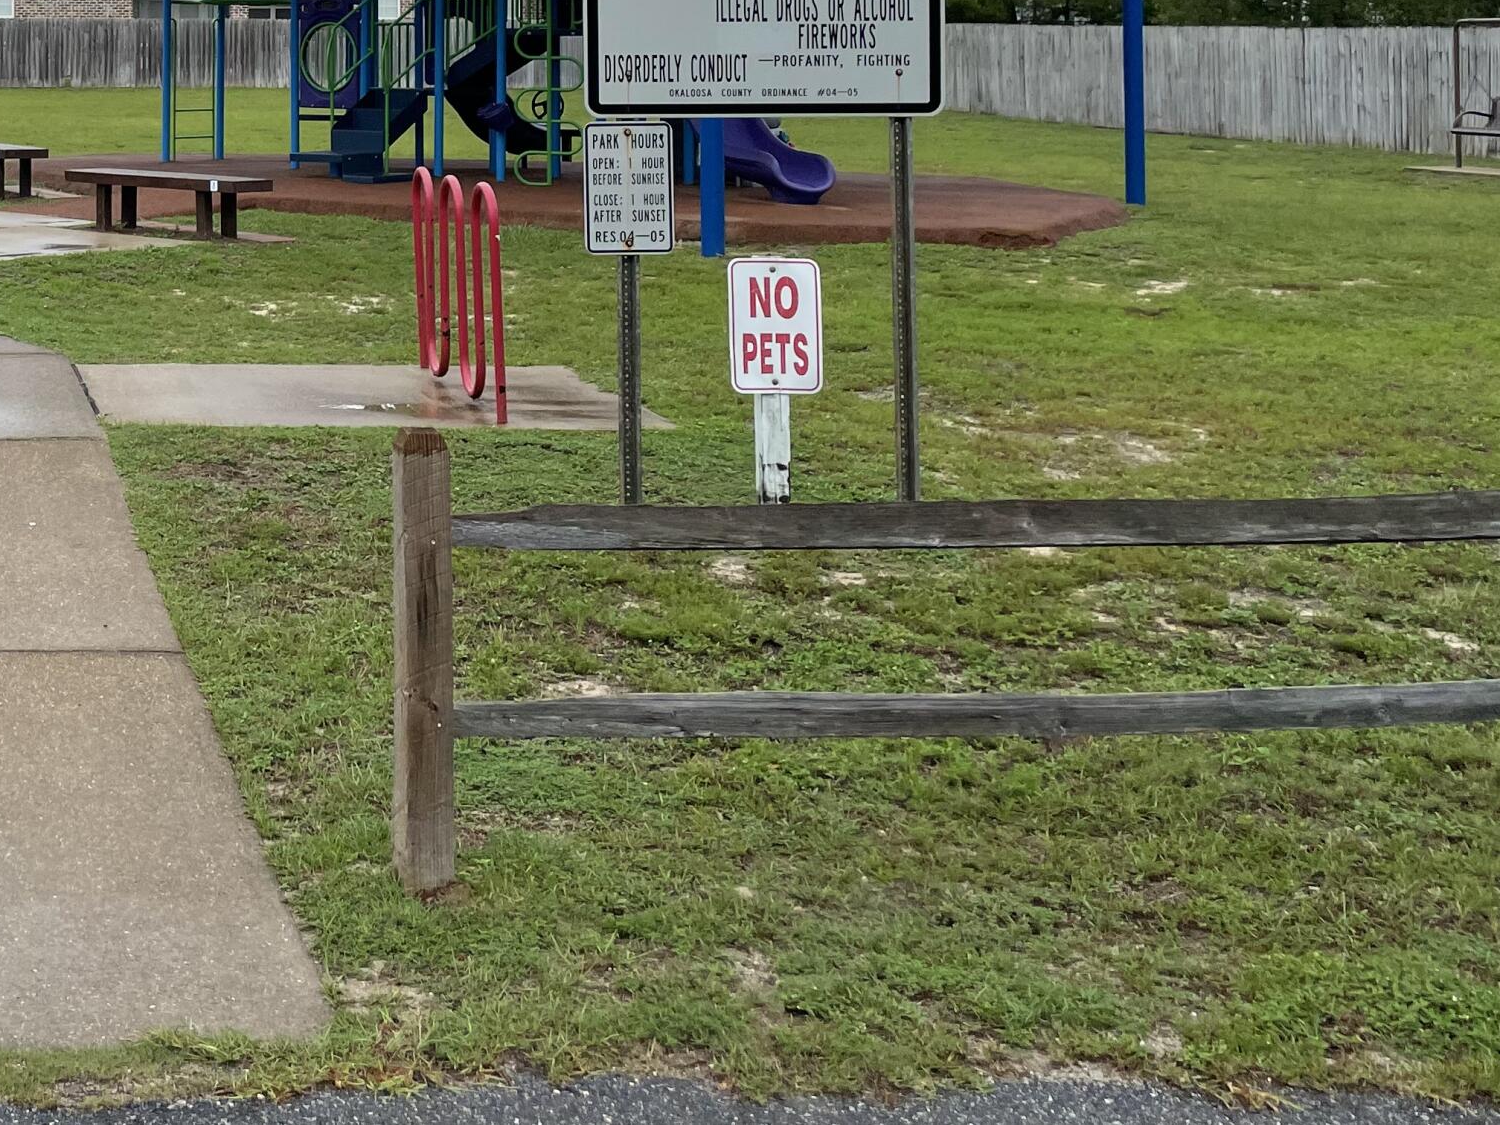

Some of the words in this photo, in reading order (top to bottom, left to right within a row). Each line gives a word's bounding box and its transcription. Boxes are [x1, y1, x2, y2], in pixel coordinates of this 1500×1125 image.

[798, 24, 876, 49] FIREWORKS
[604, 55, 681, 83] DISORDERLY
[691, 55, 747, 82] CONDUCT
[857, 54, 910, 67] FIGHTING
[669, 89, 712, 97] OKALOOSA
[721, 89, 752, 97] COUNTY
[761, 89, 807, 97] ORDINANCE
[592, 134, 619, 149] PARK
[631, 134, 664, 149] HOURS
[592, 158, 620, 169] OPEN:
[629, 158, 632, 169] 1
[642, 158, 664, 169] HOUR
[593, 173, 622, 185] BEFORE
[632, 173, 664, 185] SUNRISE
[594, 195, 622, 206] CLOSE:
[632, 195, 634, 205] 1
[644, 194, 665, 205] HOUR
[594, 210, 622, 222] AFTER
[632, 210, 666, 222] SUNSET
[749, 276, 799, 319] NO
[742, 333, 809, 375] PETS
